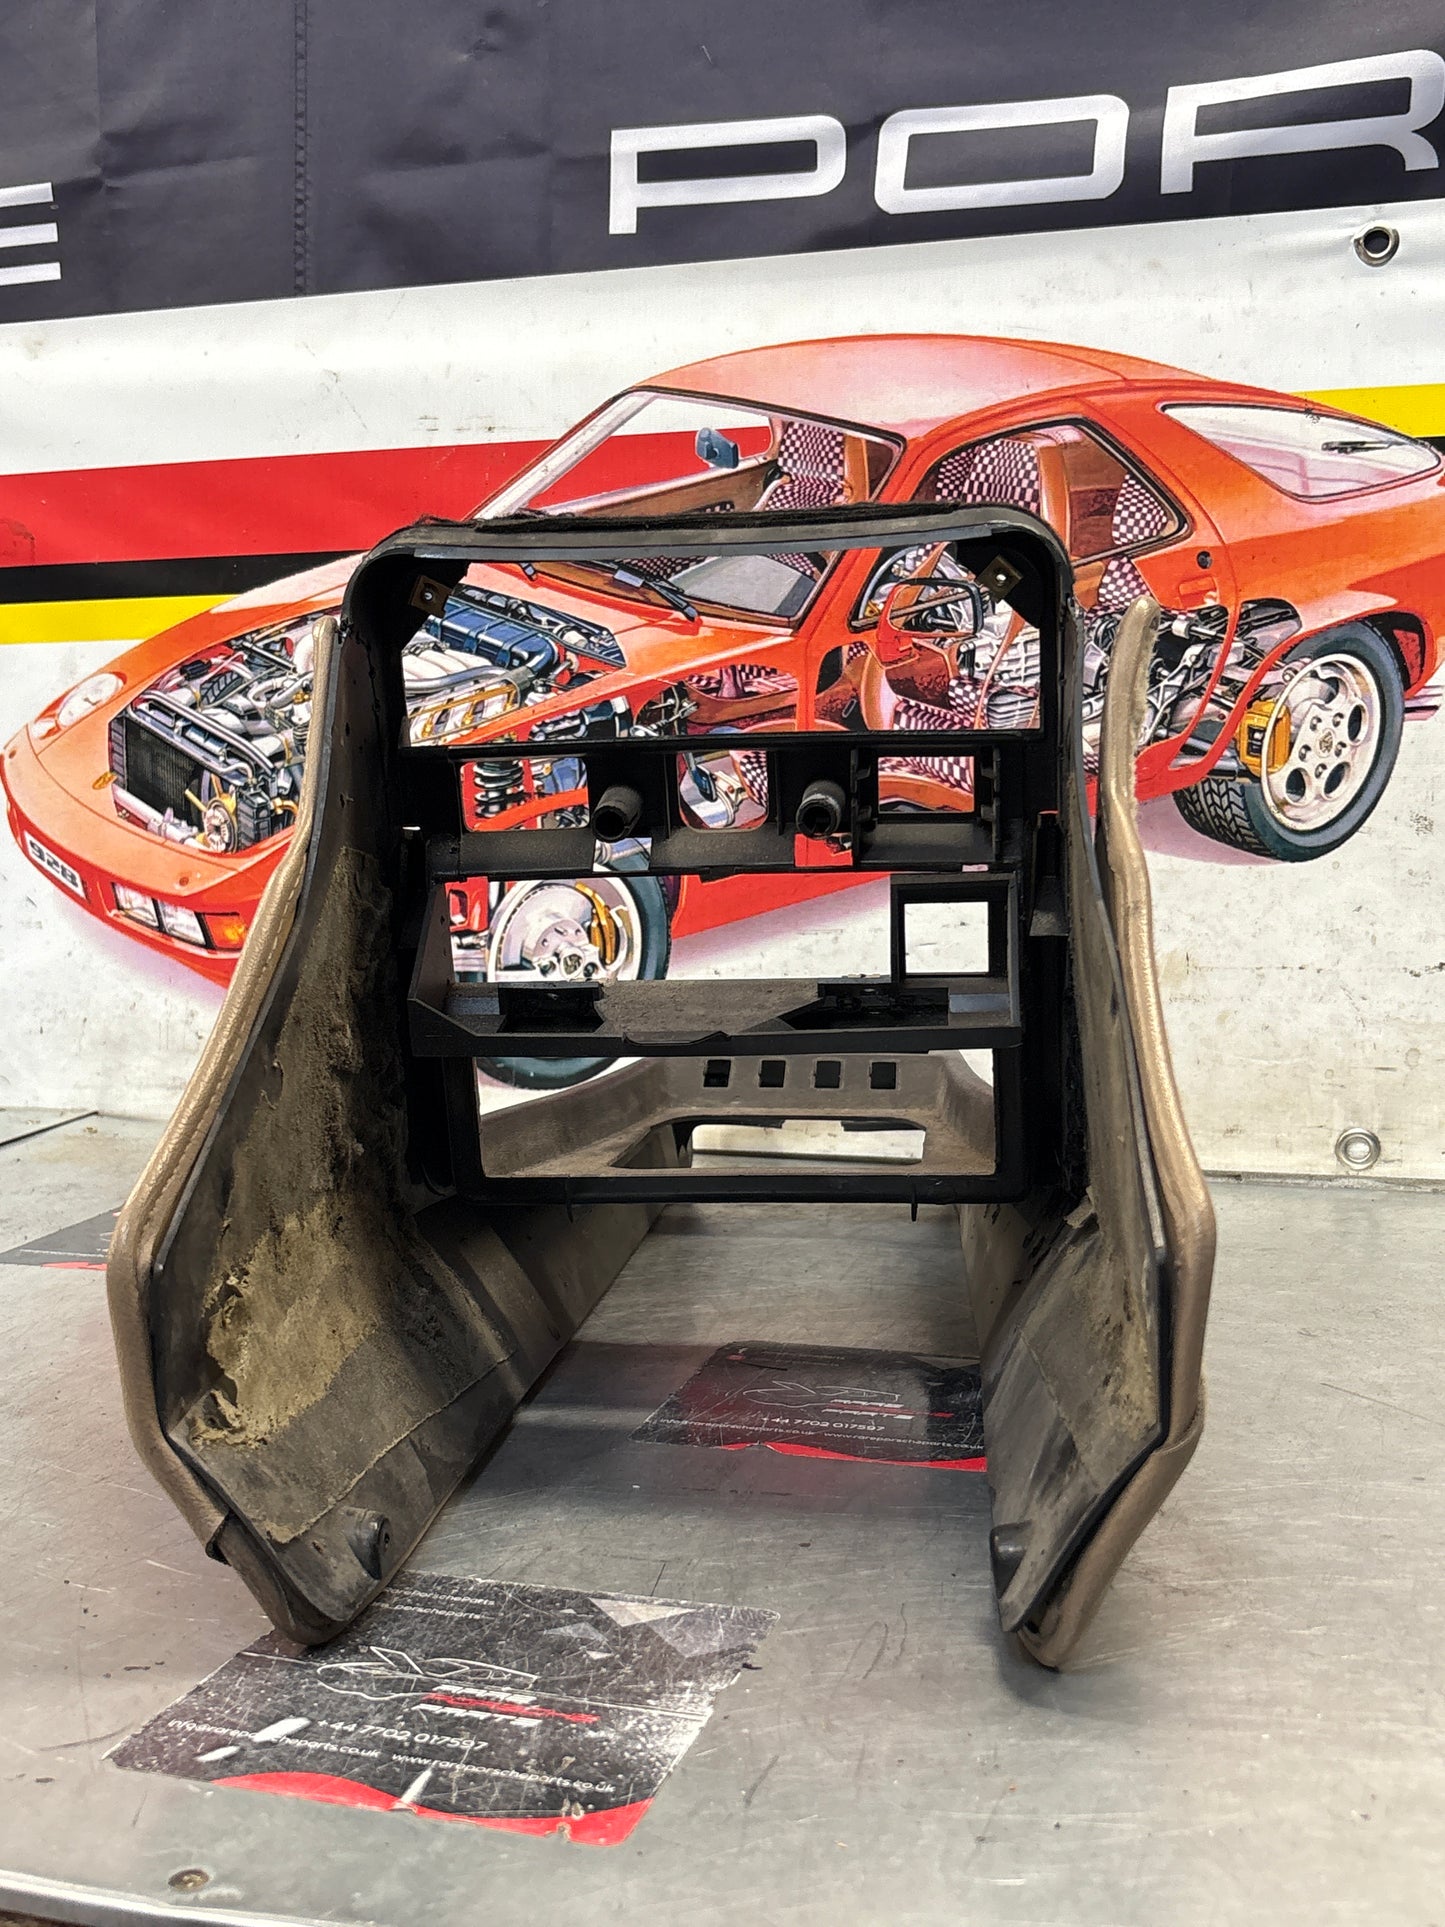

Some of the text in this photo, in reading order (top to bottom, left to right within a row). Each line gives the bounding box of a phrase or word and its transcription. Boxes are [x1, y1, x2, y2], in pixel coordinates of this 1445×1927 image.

[608, 49, 1445, 236] POR
[29, 840, 79, 888] 928
[793, 1418, 830, 1427] 7702
[832, 1421, 886, 1432] 017597
[317, 1718, 489, 1751] +44 7702 017597
[391, 1752, 617, 1794] www.rareporscheparts.co.uk
